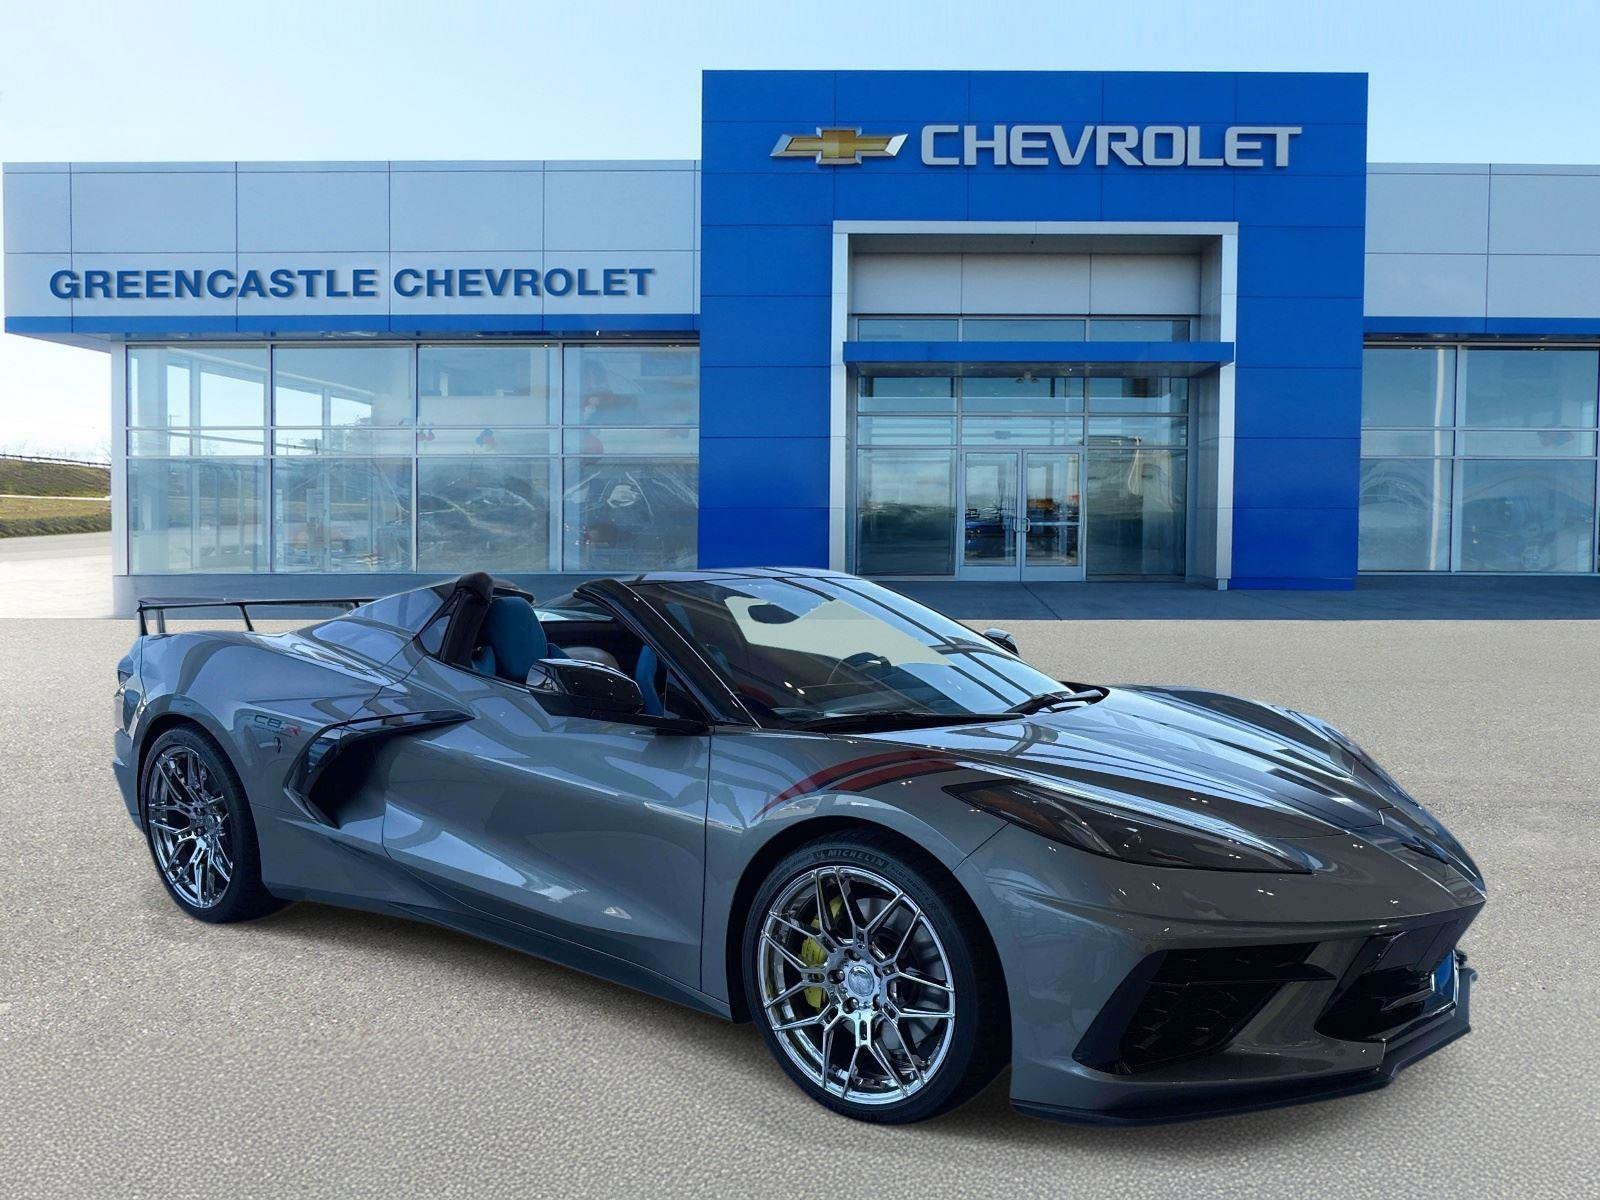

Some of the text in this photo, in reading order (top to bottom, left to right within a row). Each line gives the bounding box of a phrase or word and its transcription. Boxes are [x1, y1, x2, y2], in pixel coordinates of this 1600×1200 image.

[920, 124, 1303, 167] CHEVROLET
[50, 267, 656, 300] GREENCASTLE CHEVROLET
[827, 849, 885, 866] MICHELIN
